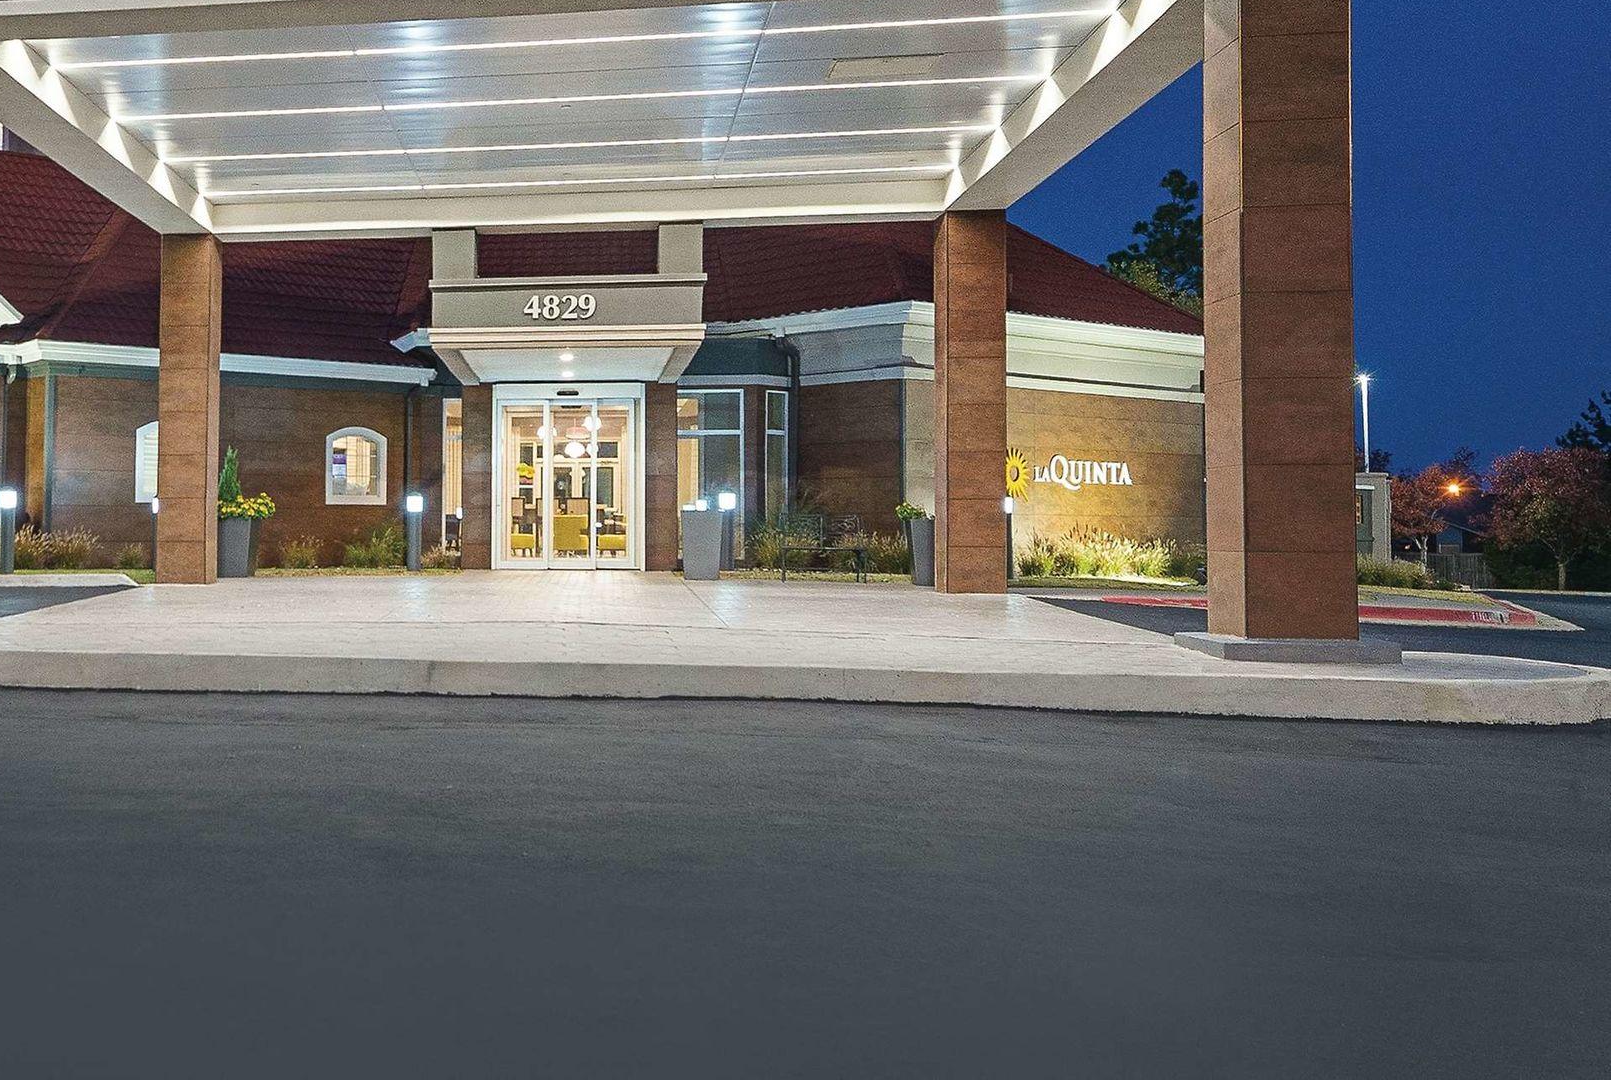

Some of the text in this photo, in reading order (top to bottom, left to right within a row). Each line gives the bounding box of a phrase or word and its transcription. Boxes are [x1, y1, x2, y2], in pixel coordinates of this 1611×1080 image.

[523, 294, 597, 319] 4829
[1033, 454, 1133, 491] LA QUINTA
